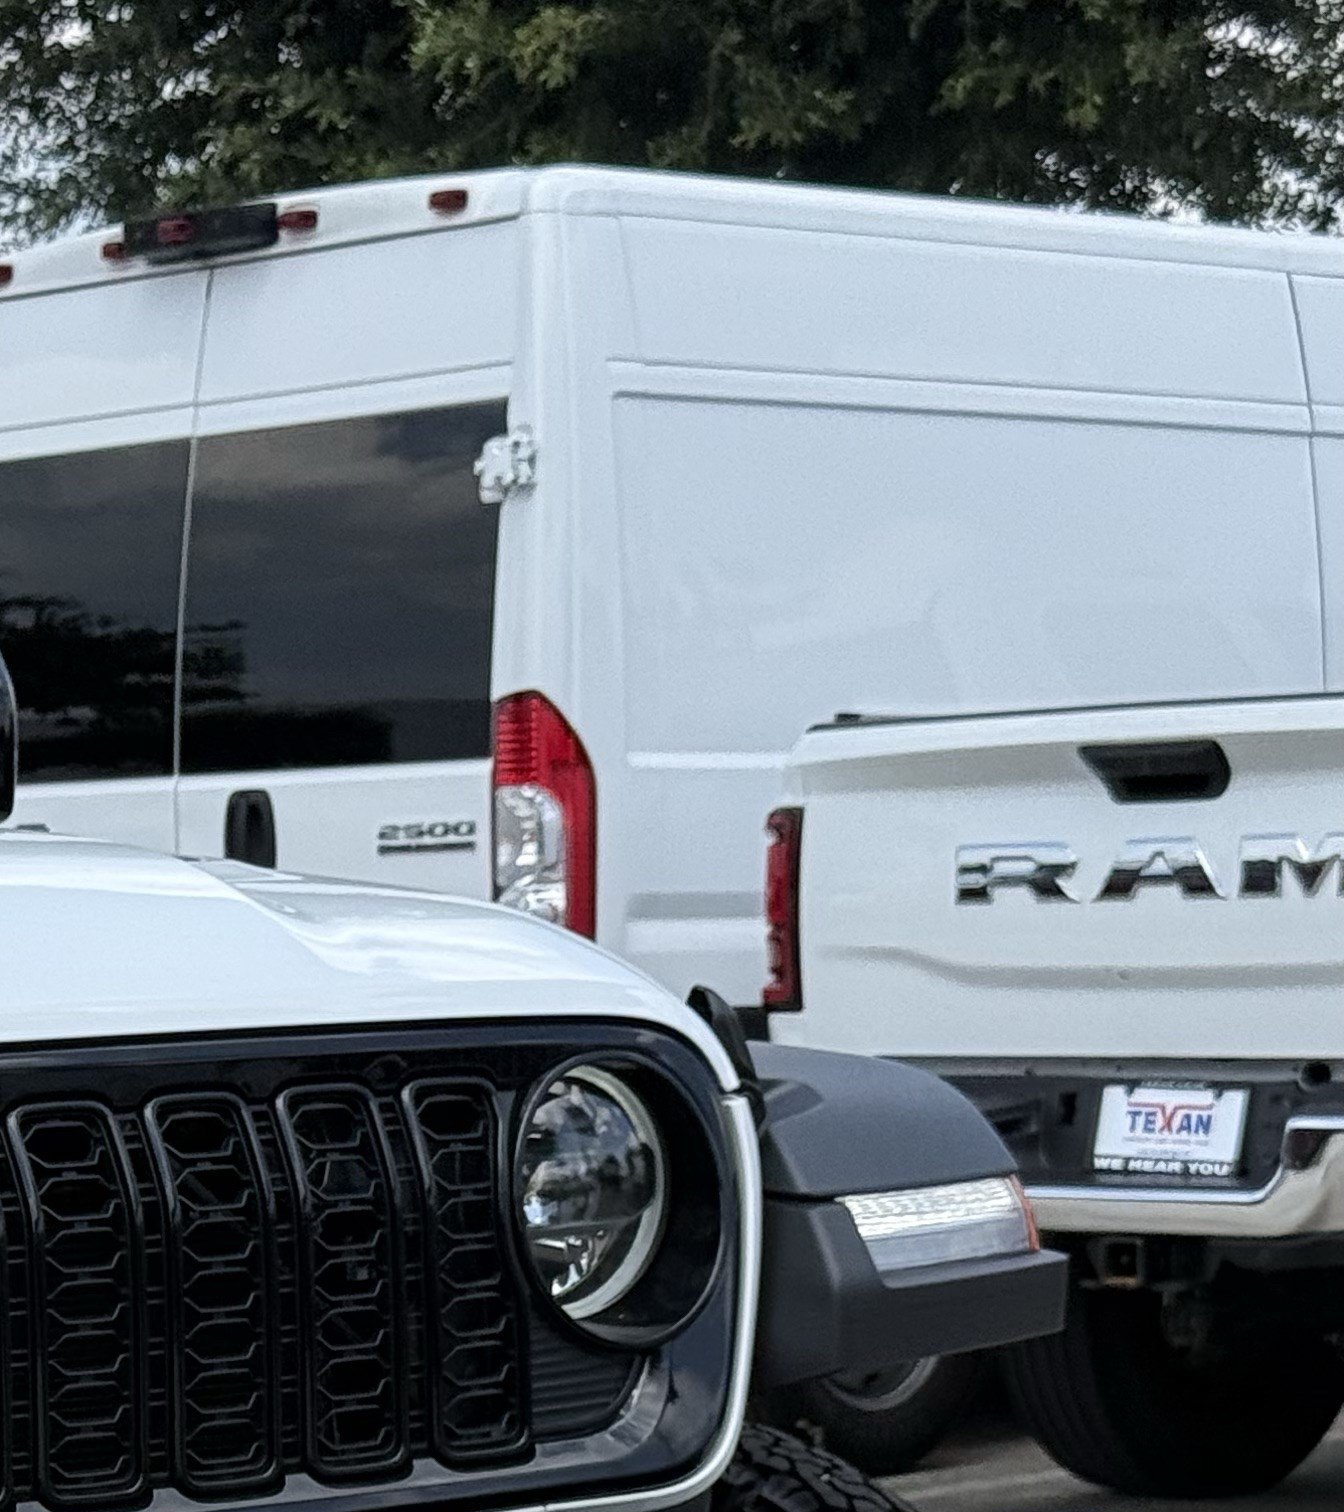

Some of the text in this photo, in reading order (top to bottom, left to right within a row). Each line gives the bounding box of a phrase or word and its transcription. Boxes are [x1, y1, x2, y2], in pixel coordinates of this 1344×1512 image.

[377, 821, 476, 841] 2500
[954, 832, 1344, 904] RAM
[1125, 1103, 1214, 1135] TEXAN
[1094, 1157, 1124, 1170] WE
[1187, 1162, 1230, 1176] YOU
